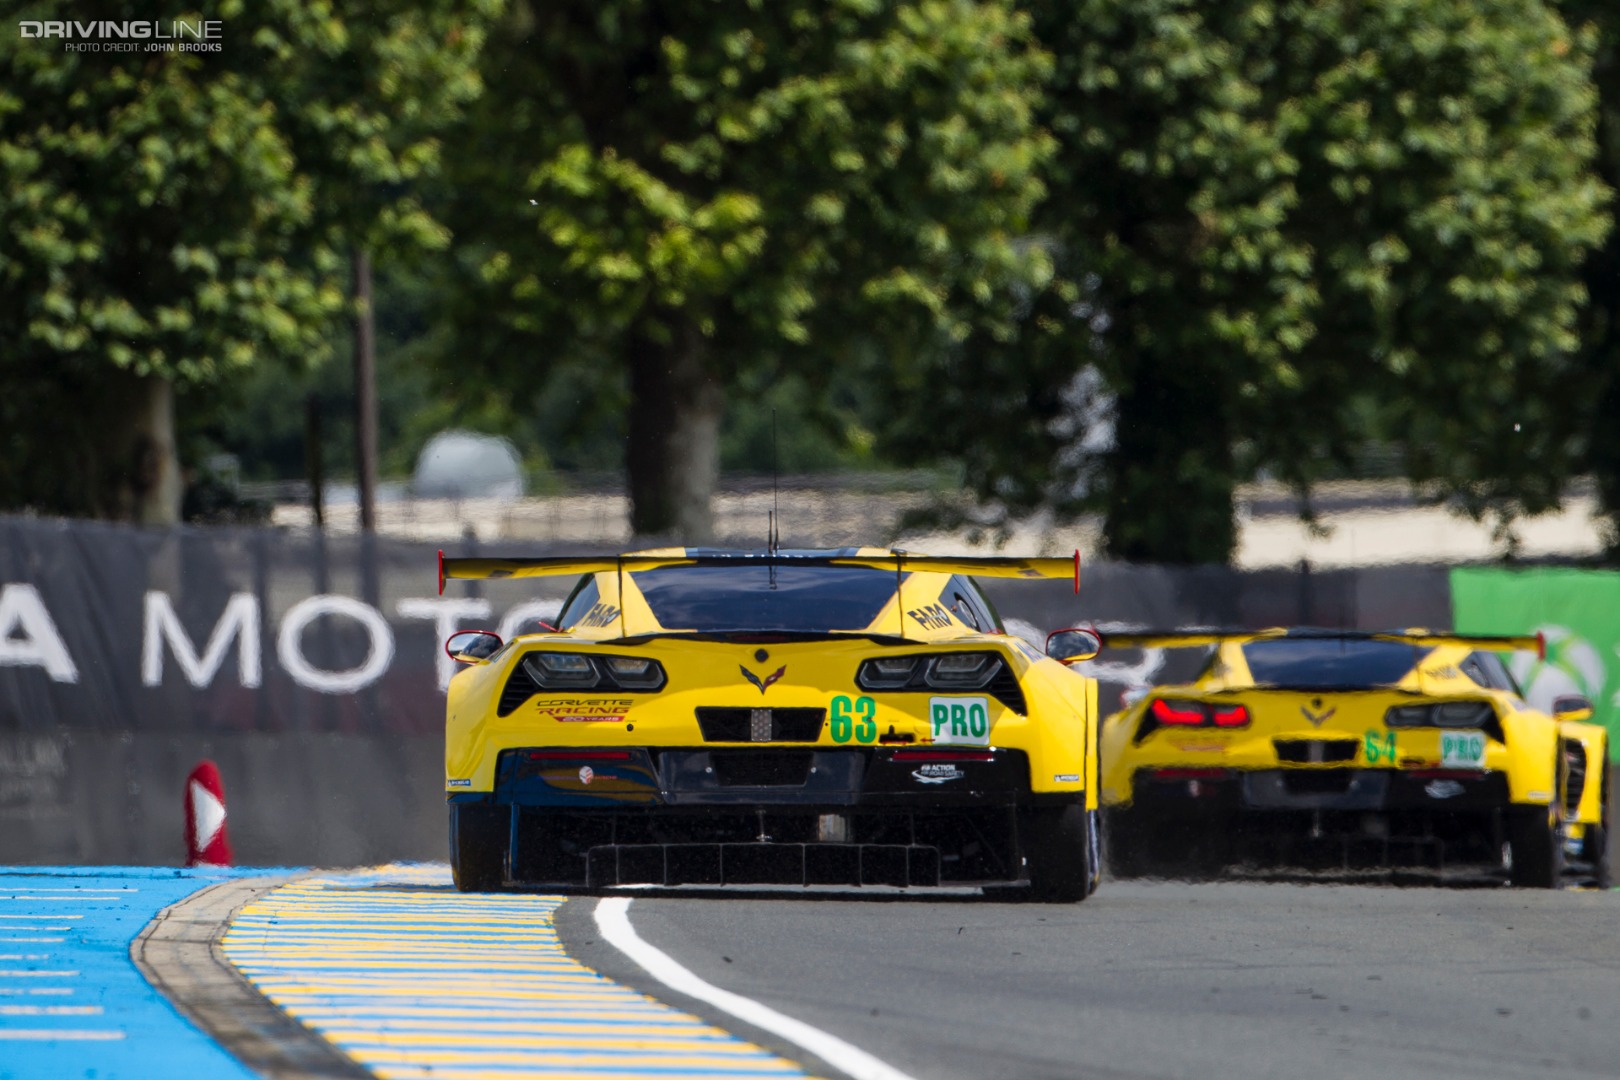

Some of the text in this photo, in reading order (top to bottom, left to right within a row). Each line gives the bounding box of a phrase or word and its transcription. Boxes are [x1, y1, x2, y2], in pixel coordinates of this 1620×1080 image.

[536, 707, 630, 716] RACING
[537, 699, 634, 707] CORVETTE
[830, 695, 876, 743] 63
[932, 703, 986, 738] PRO
[1365, 729, 1396, 763] 64
[1443, 735, 1483, 761] PRO
